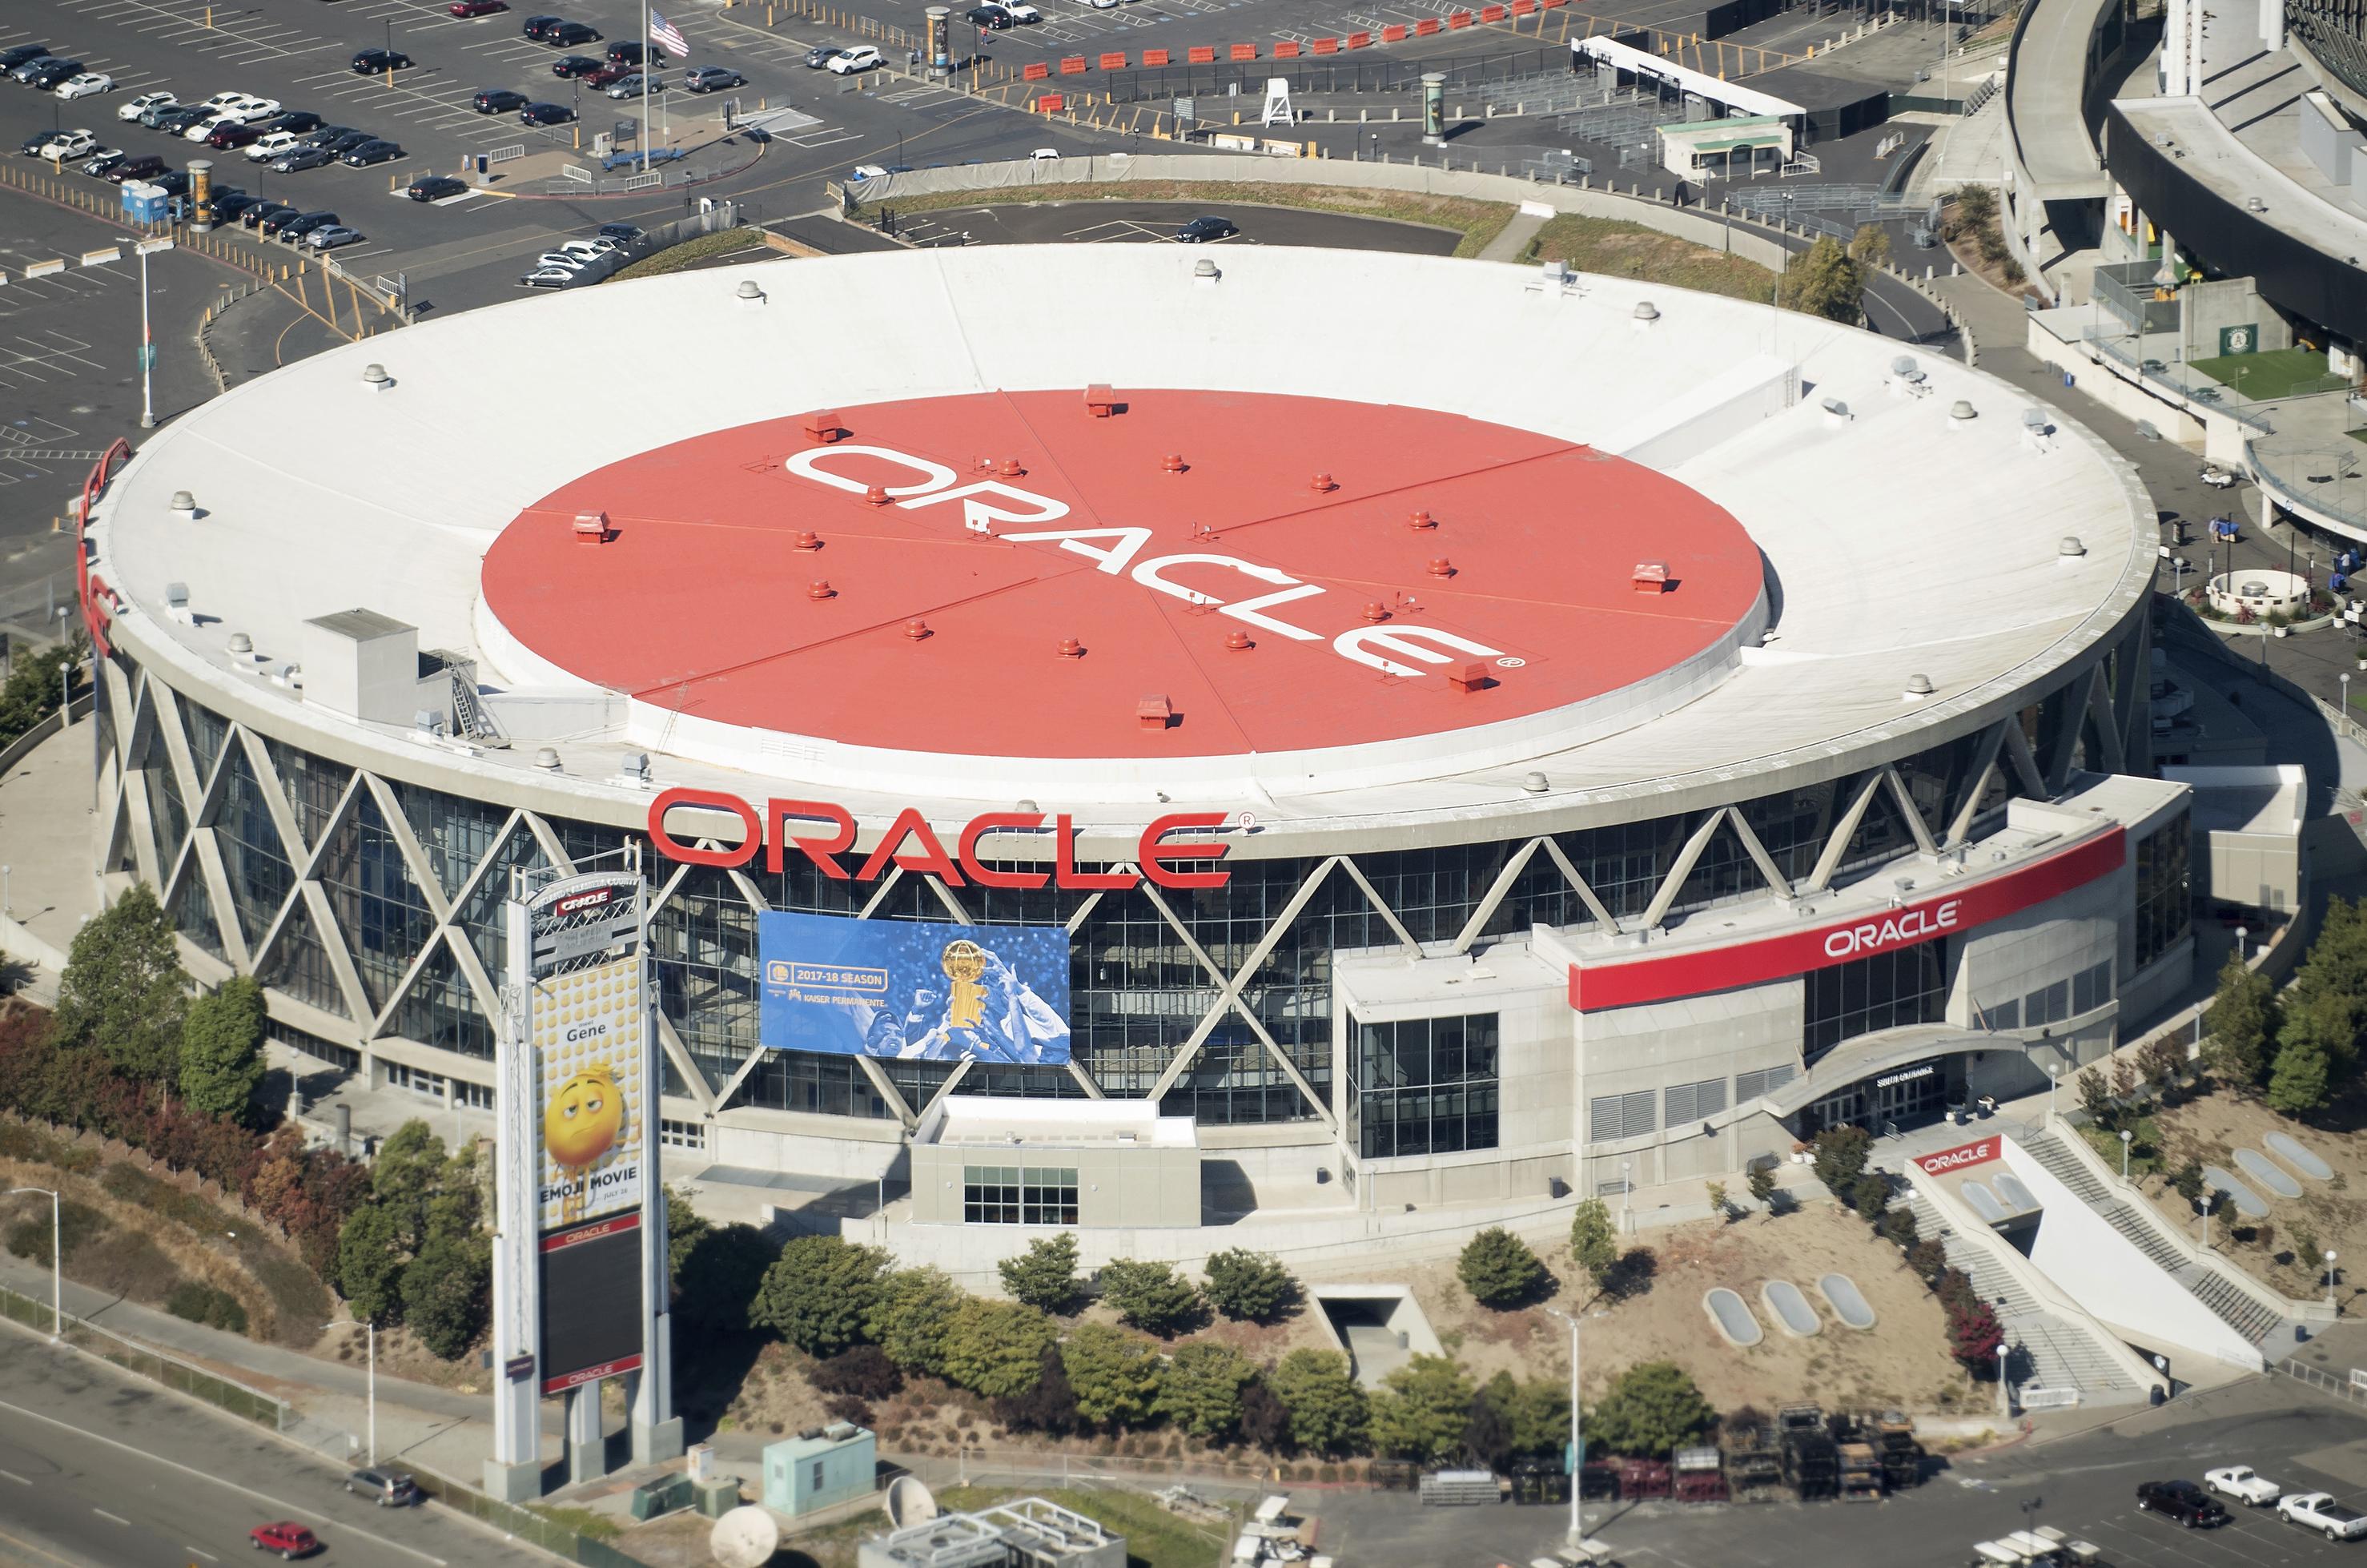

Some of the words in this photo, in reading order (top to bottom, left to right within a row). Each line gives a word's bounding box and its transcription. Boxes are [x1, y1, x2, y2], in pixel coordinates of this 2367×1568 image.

[561, 891, 609, 911] ORACLE
[797, 970, 839, 983] 2017-18
[841, 972, 882, 985] SEASON
[804, 994, 830, 1004] KAISER
[566, 1024, 606, 1042] Gene
[540, 1180, 585, 1204] EMOJI
[590, 1166, 637, 1189] MOVIE
[565, 1223, 610, 1243] ORACLE
[569, 1365, 614, 1384] ORACLE
